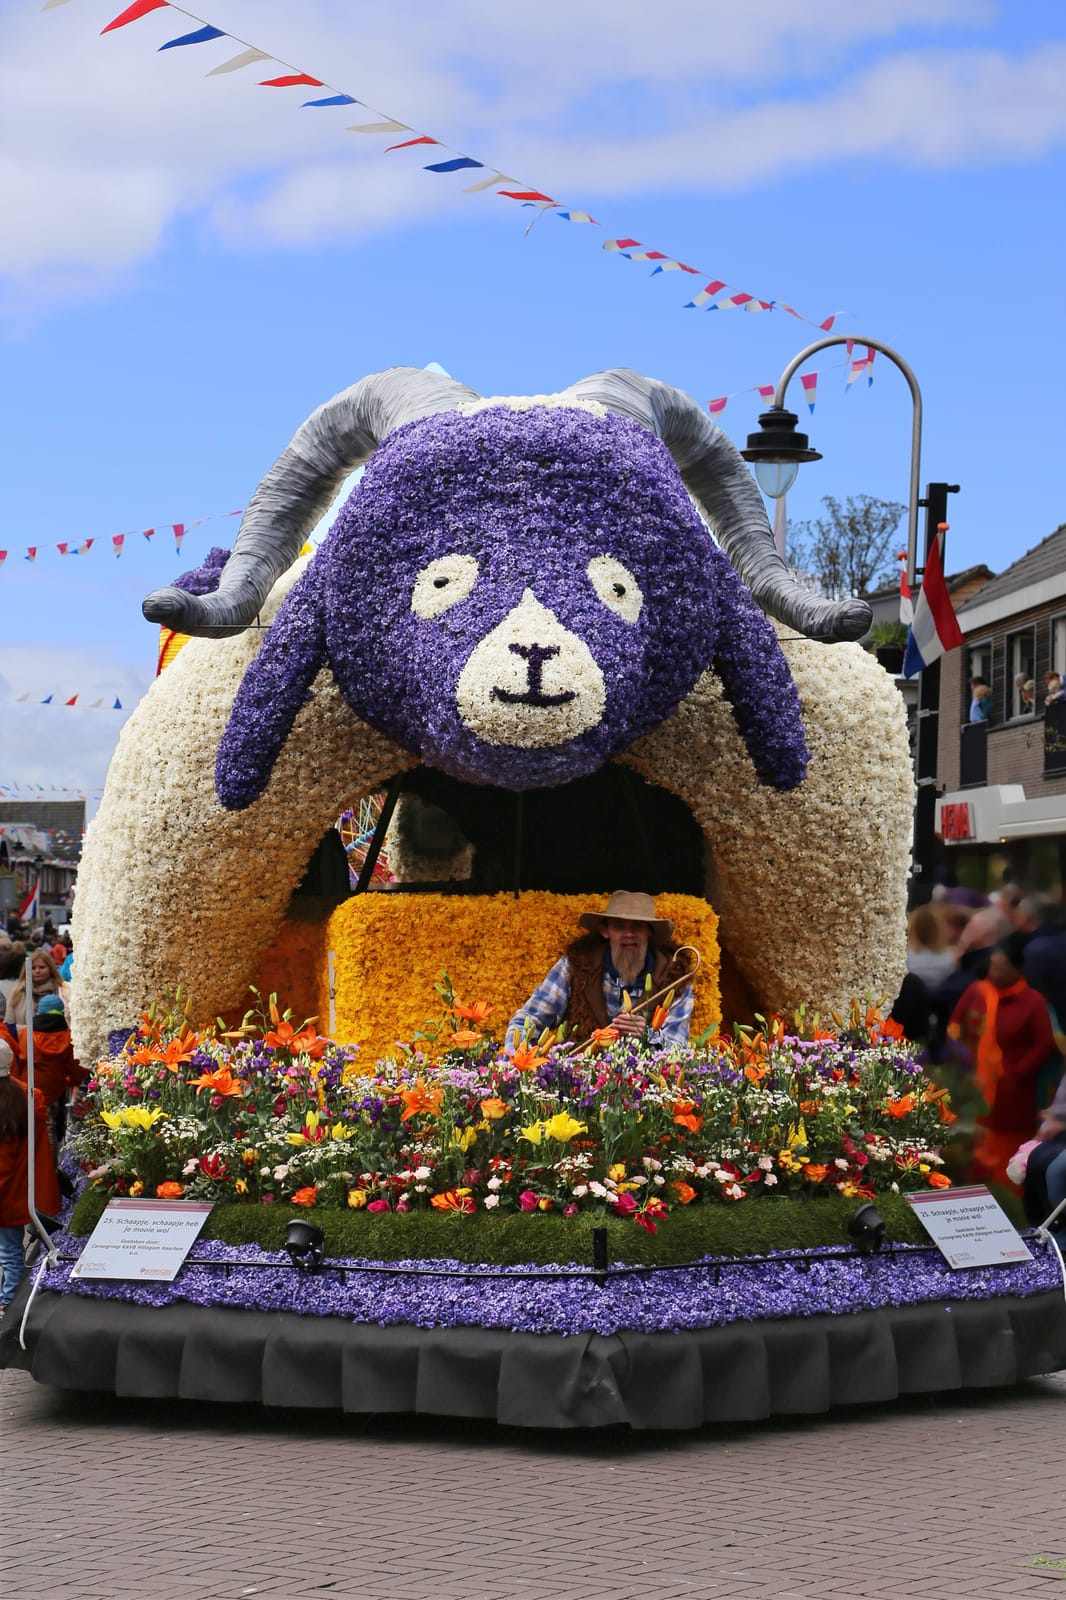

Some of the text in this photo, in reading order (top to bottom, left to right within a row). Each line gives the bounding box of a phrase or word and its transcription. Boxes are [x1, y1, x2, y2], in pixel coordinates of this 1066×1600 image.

[941, 801, 970, 839] HEMA
[931, 1209, 960, 1217] Schaapje,
[960, 1206, 984, 1214] schaapje
[116, 1218, 150, 1227] Schaapje,
[151, 1219, 184, 1227] schaapje
